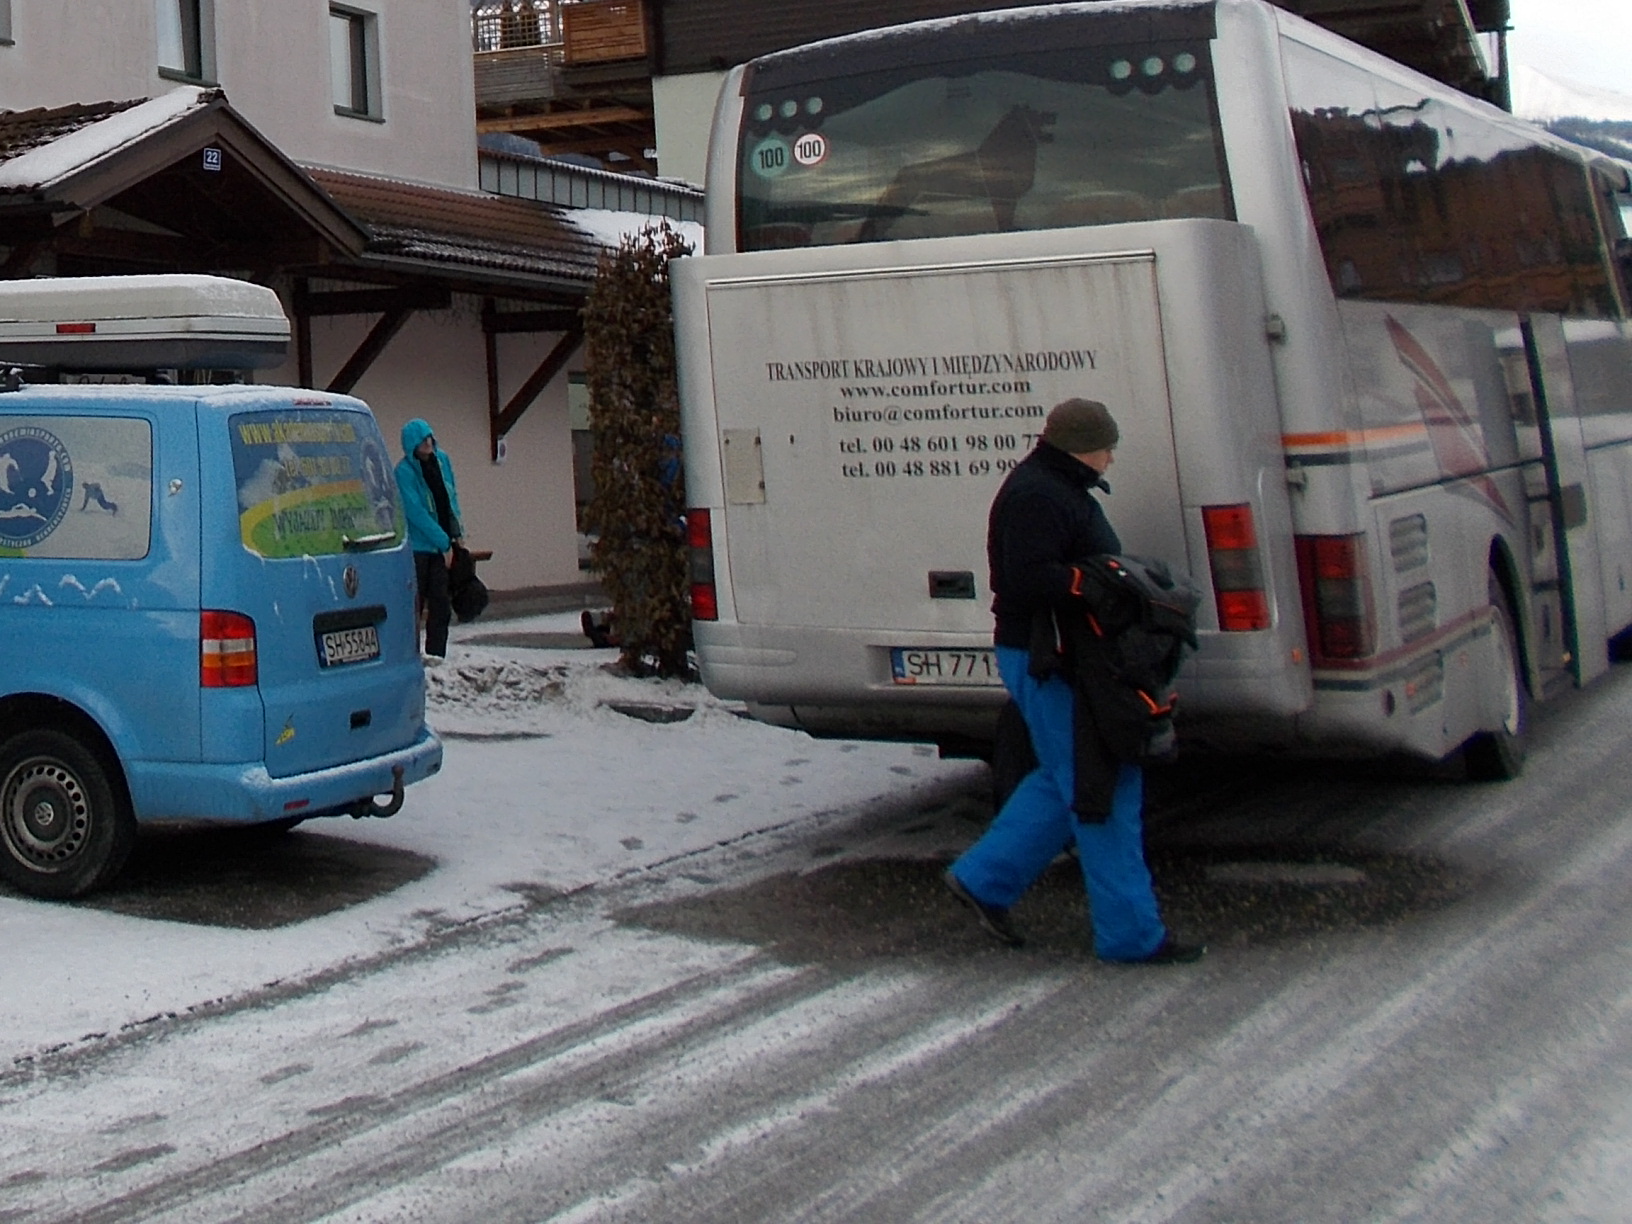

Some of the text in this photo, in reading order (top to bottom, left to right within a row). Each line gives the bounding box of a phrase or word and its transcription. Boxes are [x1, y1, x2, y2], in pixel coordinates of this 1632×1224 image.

[206, 151, 218, 163] 22
[758, 147, 784, 169] 100
[797, 139, 821, 159] 100
[766, 359, 849, 382] TRANSPORT
[854, 357, 929, 378] KRAJOWY
[931, 357, 938, 376] I
[840, 379, 1032, 399] www.comfortur.com
[833, 403, 1045, 424] biuro@comfortur.com
[839, 437, 868, 454] tel.
[872, 437, 894, 453] 00
[900, 436, 921, 452] 48
[927, 436, 958, 452] 601
[966, 434, 988, 451] 98
[994, 434, 1016, 450] 00
[842, 461, 870, 478] tel.
[875, 461, 896, 478] 00
[902, 460, 924, 477] 48
[930, 460, 960, 476] 881
[969, 459, 991, 476] 69
[908, 653, 1000, 676] SH 771
